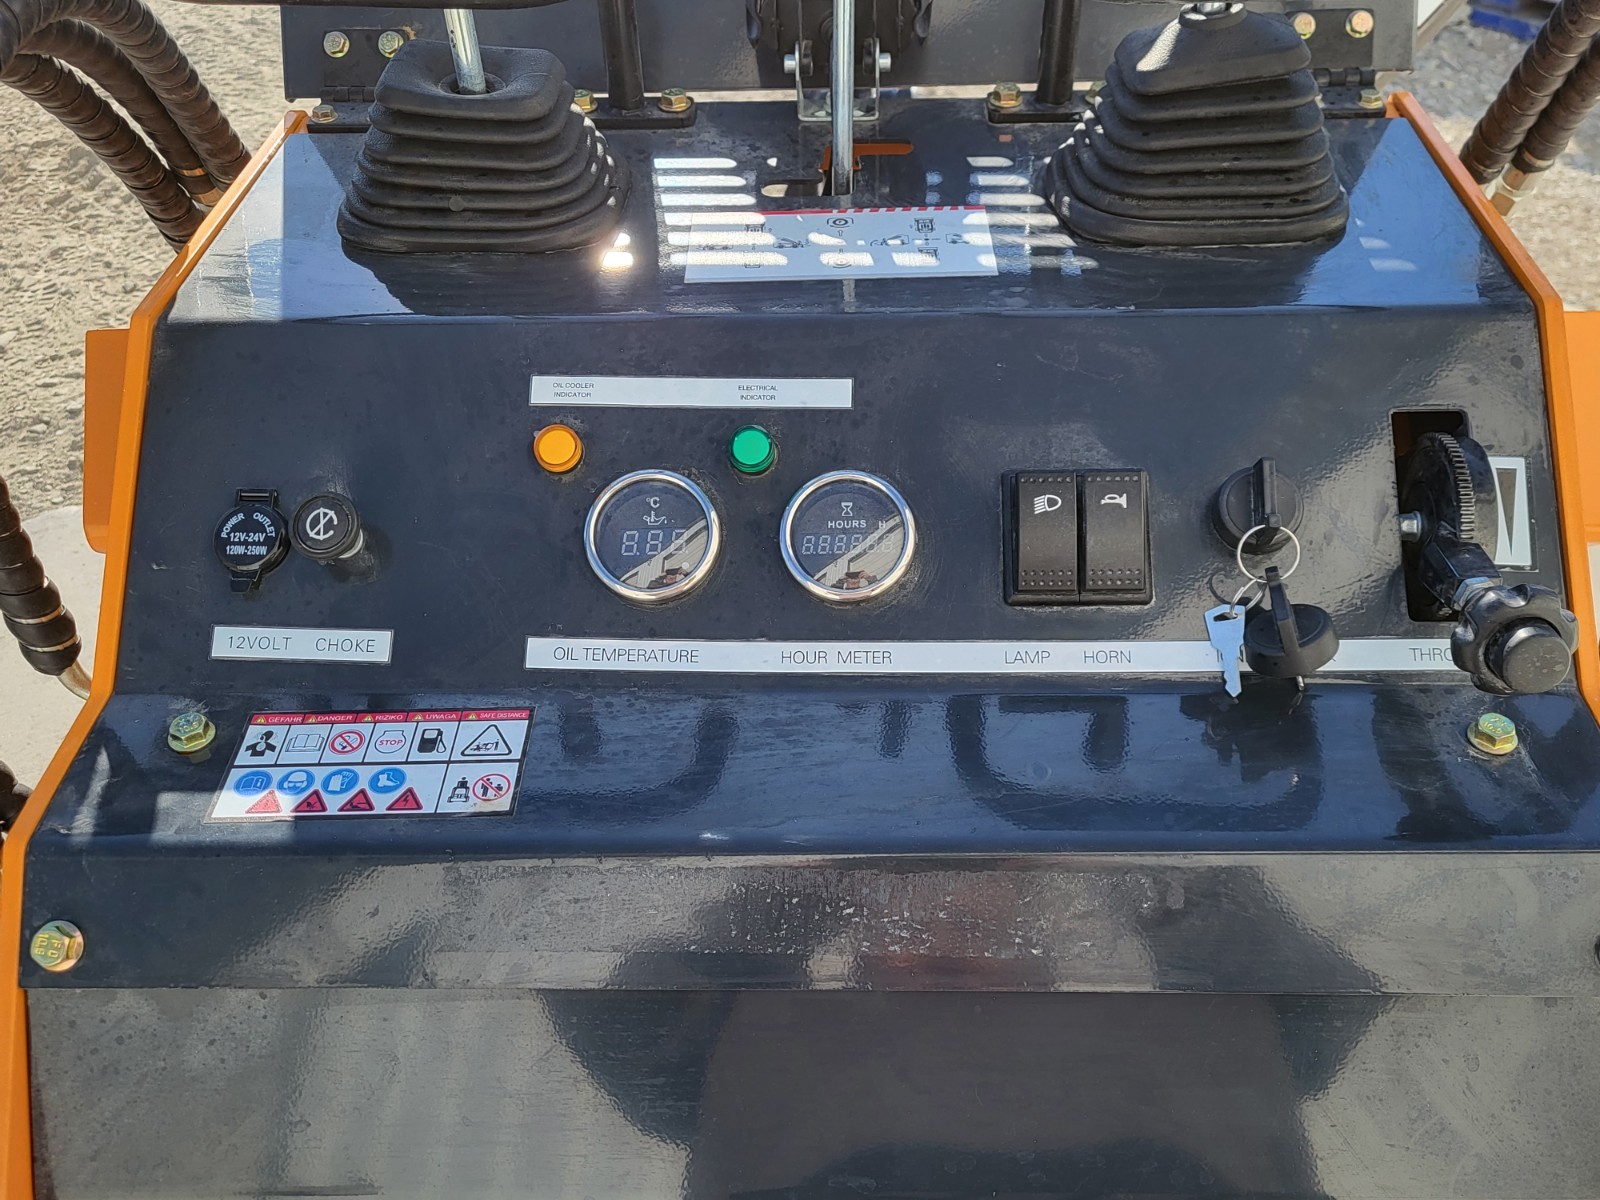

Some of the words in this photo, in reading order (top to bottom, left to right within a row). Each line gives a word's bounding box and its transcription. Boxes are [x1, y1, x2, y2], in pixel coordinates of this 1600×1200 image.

[737, 384, 778, 392] ELECTRICAL
[220, 512, 245, 538] POWER
[252, 511, 276, 538] OUTLET
[827, 520, 867, 529] HOURS
[229, 532, 267, 543] 12V-24V
[225, 545, 268, 556] 120W-250W
[227, 636, 293, 651] 12VOLT
[315, 637, 377, 653] CHOKE
[553, 646, 579, 661] OIL
[581, 647, 700, 664] TEMPERATURE
[780, 650, 829, 665] HOUR
[836, 650, 893, 665] METER
[1004, 650, 1051, 665] LAMP
[1083, 650, 1132, 665] HORN
